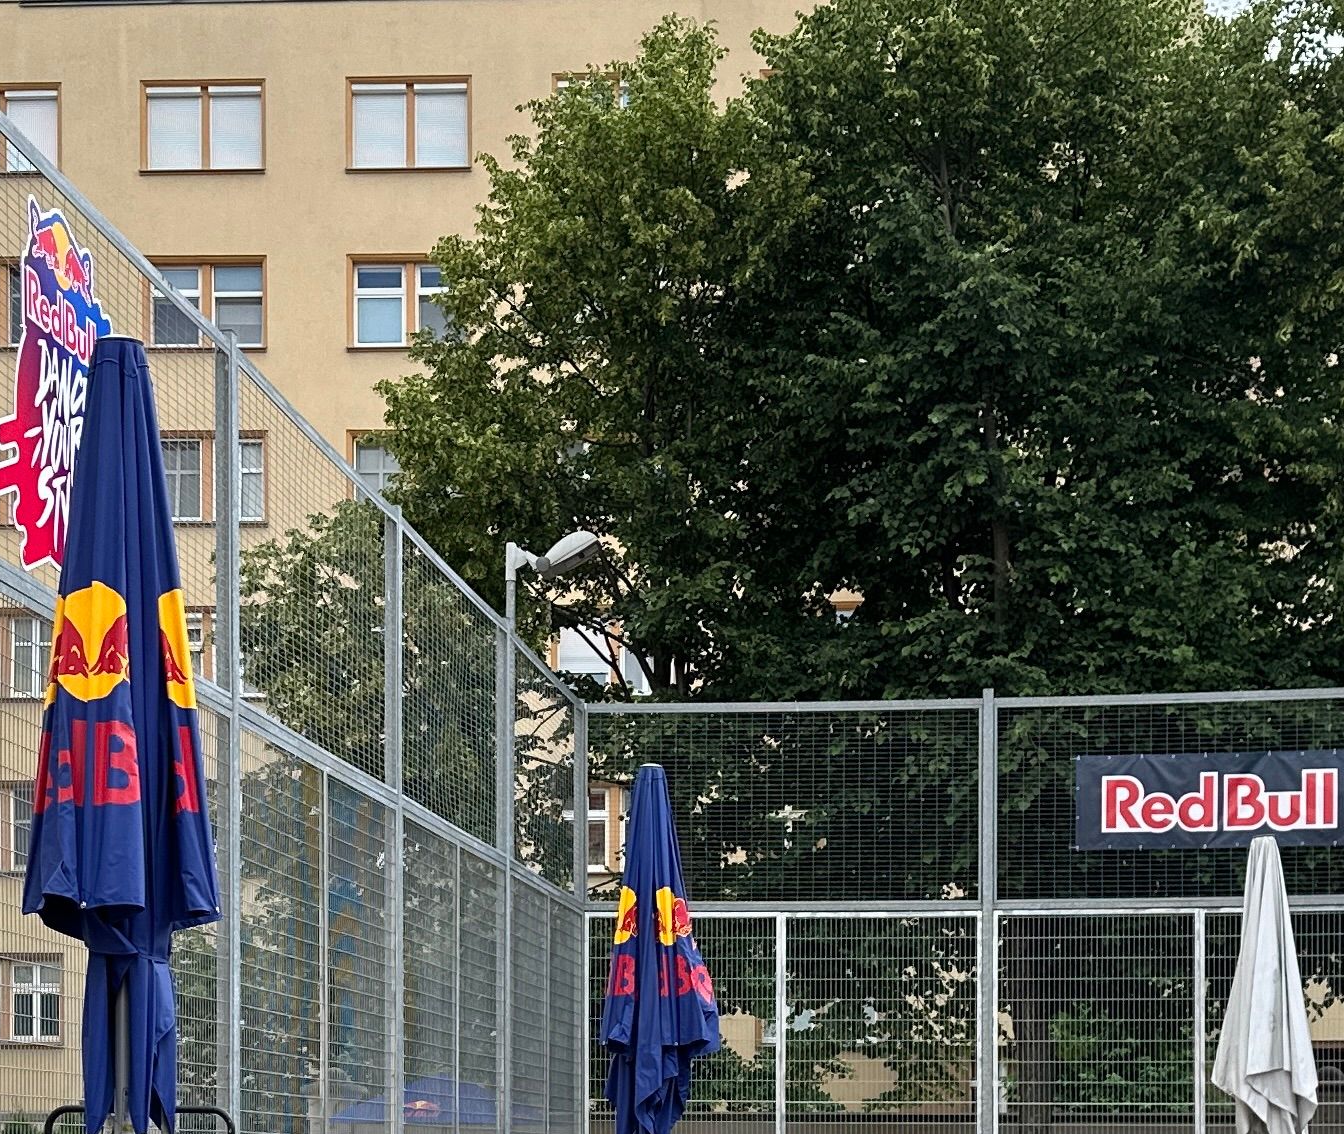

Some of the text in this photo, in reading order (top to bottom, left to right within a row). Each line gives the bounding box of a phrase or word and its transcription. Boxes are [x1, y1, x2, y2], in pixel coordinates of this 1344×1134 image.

[26, 265, 64, 346] Red
[1102, 771, 1219, 833] Red
[1223, 768, 1338, 831] Bull
